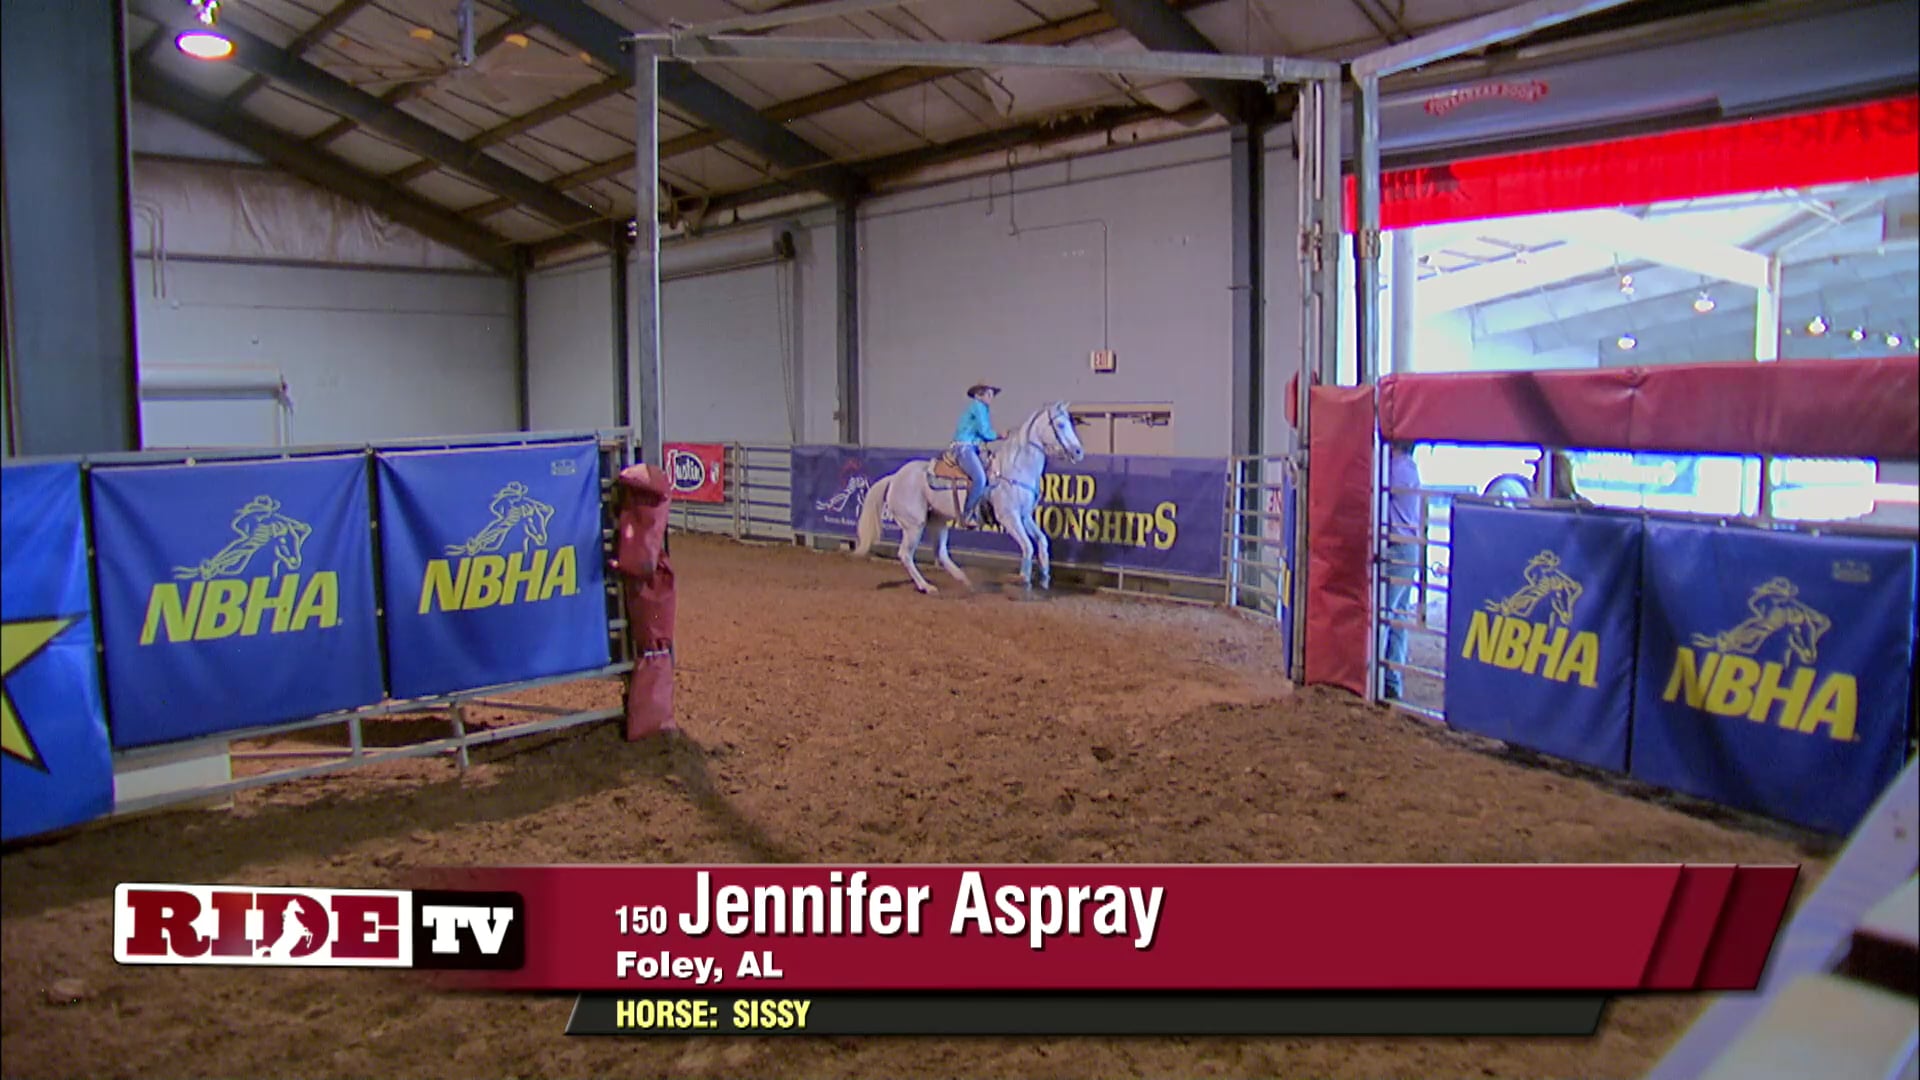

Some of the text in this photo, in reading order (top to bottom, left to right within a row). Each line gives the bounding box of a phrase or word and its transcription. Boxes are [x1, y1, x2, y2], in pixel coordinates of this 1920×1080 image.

[1039, 472, 1096, 505] RLD
[140, 570, 338, 646] NBHA
[421, 547, 577, 615] NBHA
[1462, 610, 1600, 688] NBHA
[1662, 646, 1858, 742] NBHA
